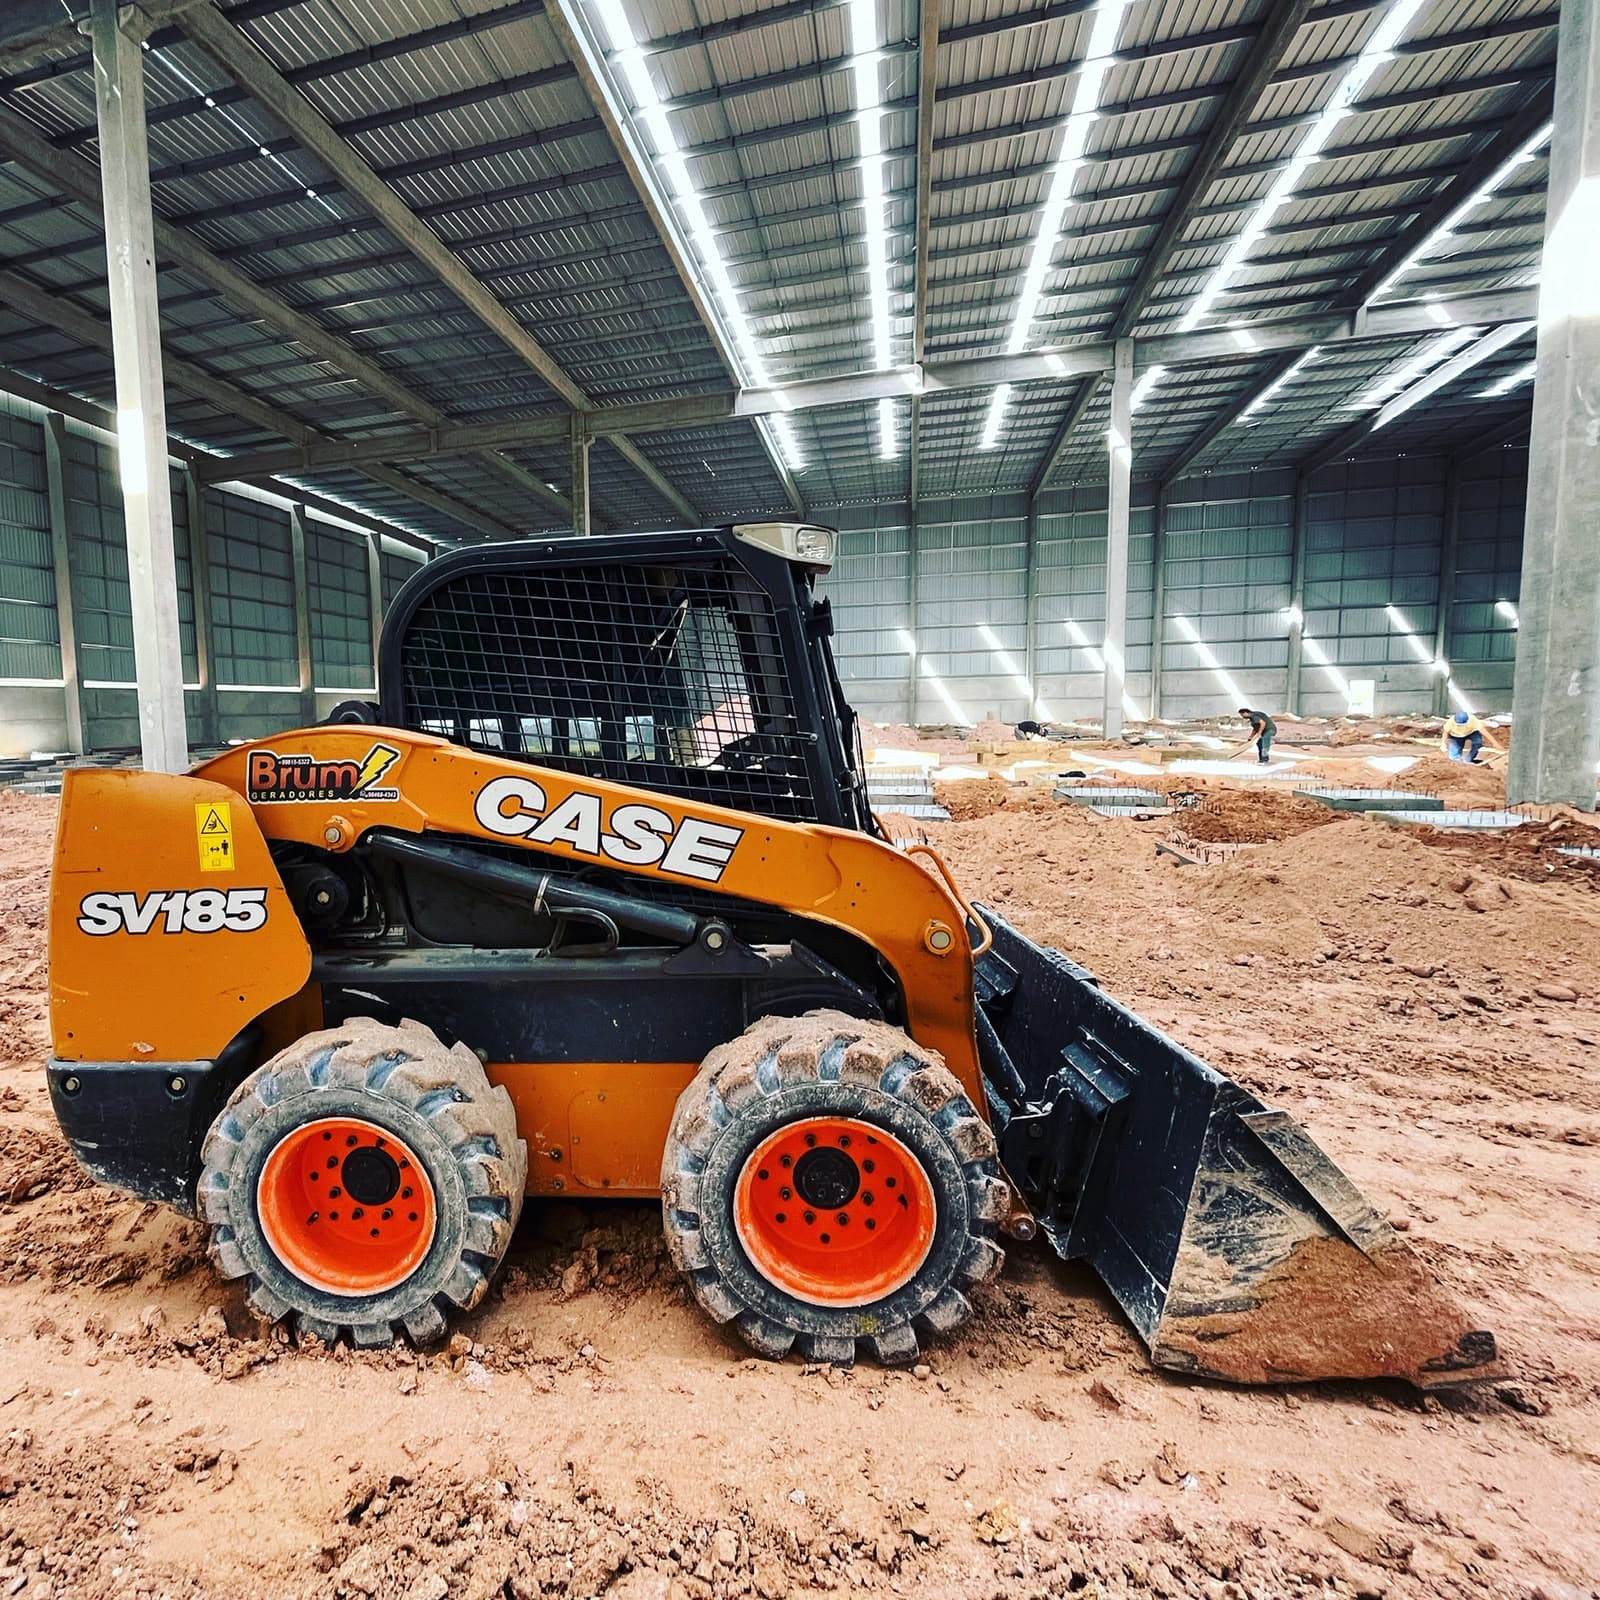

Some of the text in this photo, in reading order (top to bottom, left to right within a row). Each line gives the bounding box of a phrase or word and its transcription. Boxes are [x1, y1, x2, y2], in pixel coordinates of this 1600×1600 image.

[252, 755, 358, 789] Brum
[251, 790, 334, 800] GERADORES
[474, 775, 746, 883] CASE
[77, 887, 268, 936] SV185
